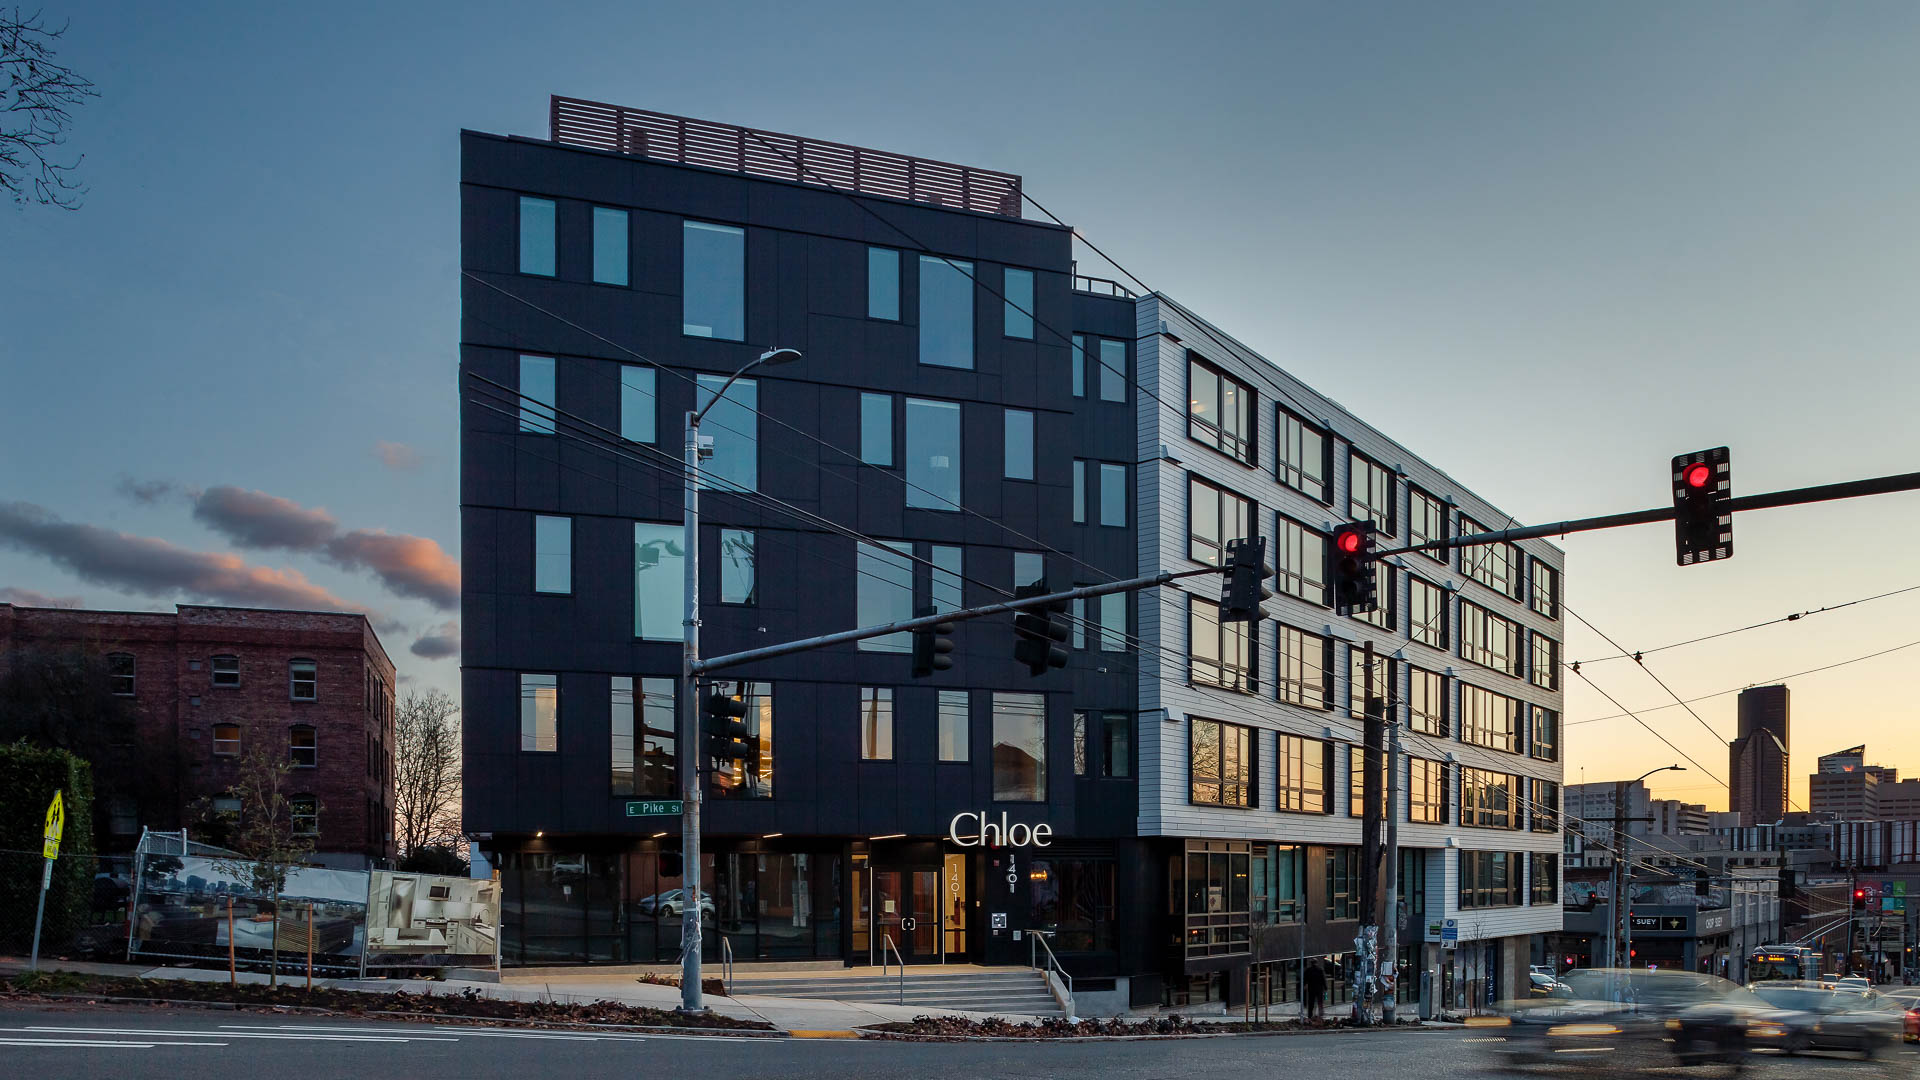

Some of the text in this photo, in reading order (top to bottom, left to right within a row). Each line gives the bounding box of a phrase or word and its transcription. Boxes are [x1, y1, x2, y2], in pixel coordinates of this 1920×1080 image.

[643, 803, 665, 814] Pike
[672, 805, 680, 813] St
[950, 811, 1052, 847] Chloe
[951, 863, 960, 901] 1401
[1008, 854, 1017, 893] 1401
